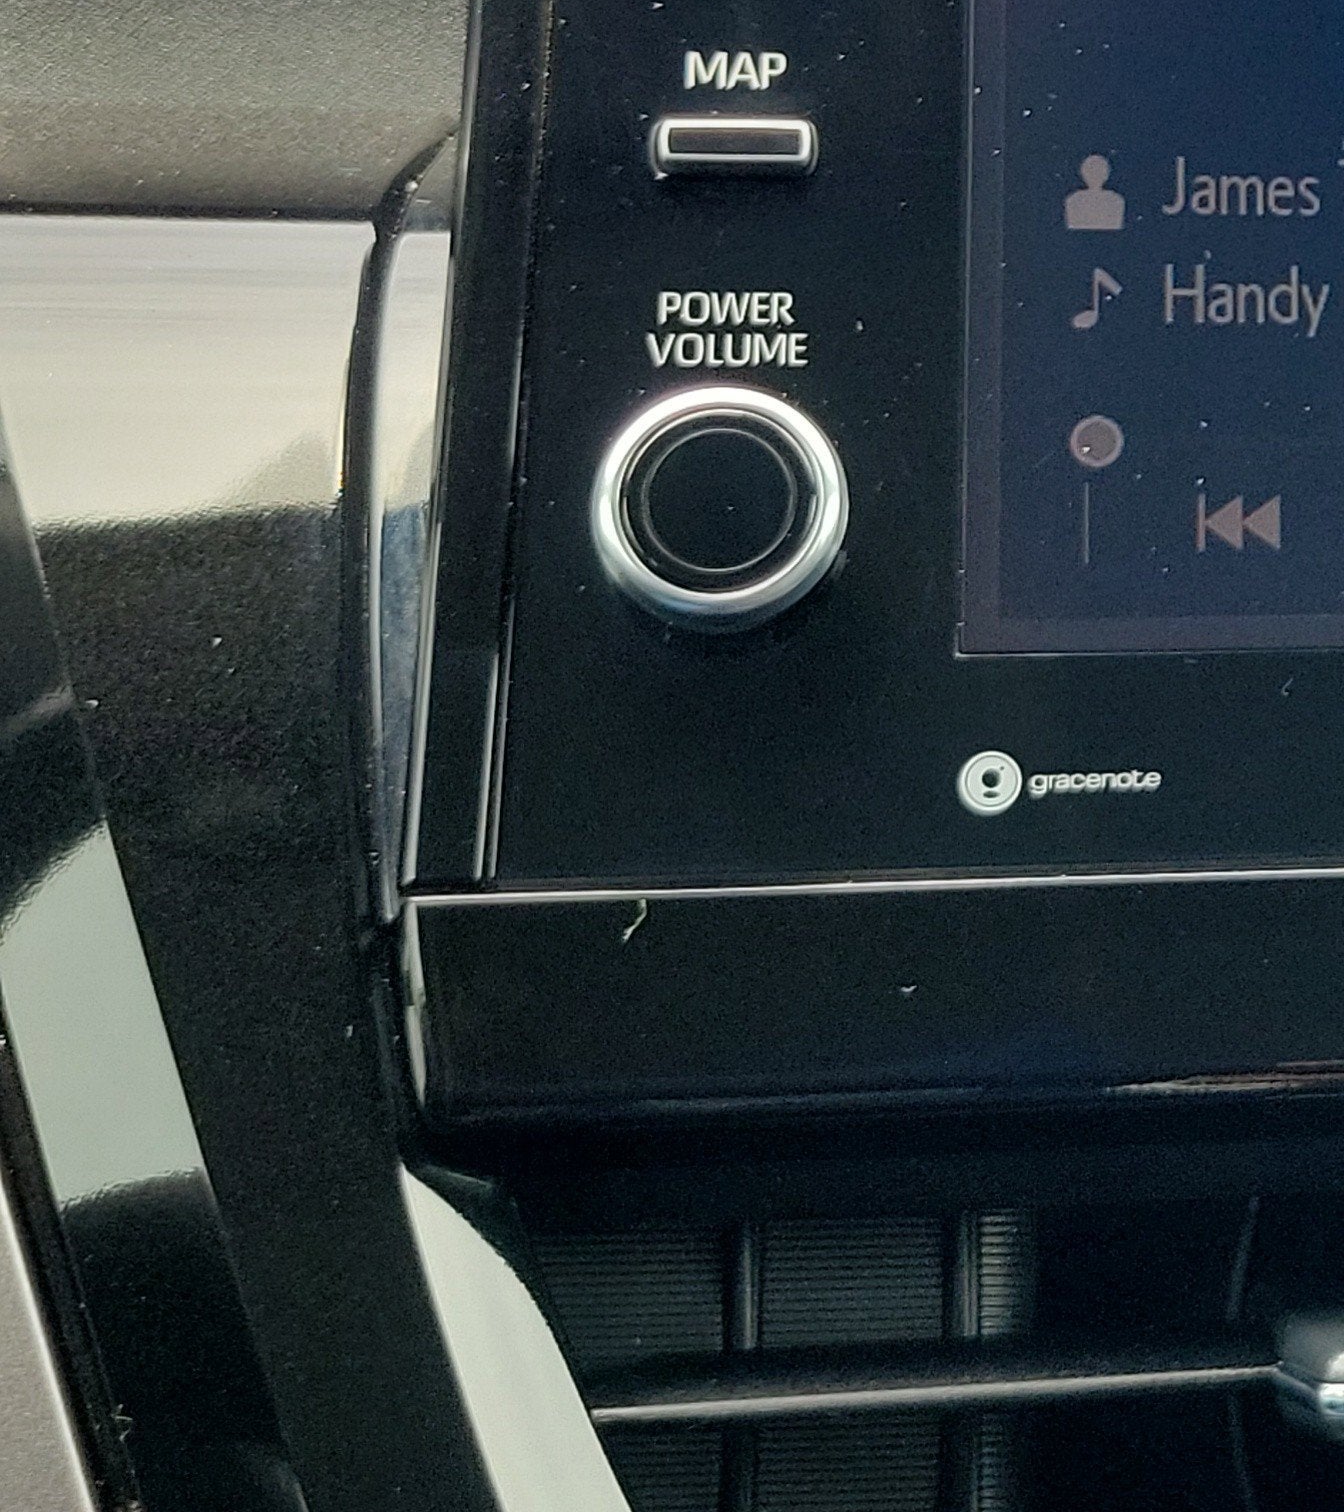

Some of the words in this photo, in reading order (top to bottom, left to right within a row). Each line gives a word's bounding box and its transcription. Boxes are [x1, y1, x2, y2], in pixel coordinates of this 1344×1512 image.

[684, 50, 788, 91] MAP
[1162, 155, 1322, 217] James
[656, 290, 795, 328] POWER
[1163, 262, 1330, 338] Handy
[646, 330, 810, 368] VOLUME
[1027, 769, 1162, 800] gracenote
